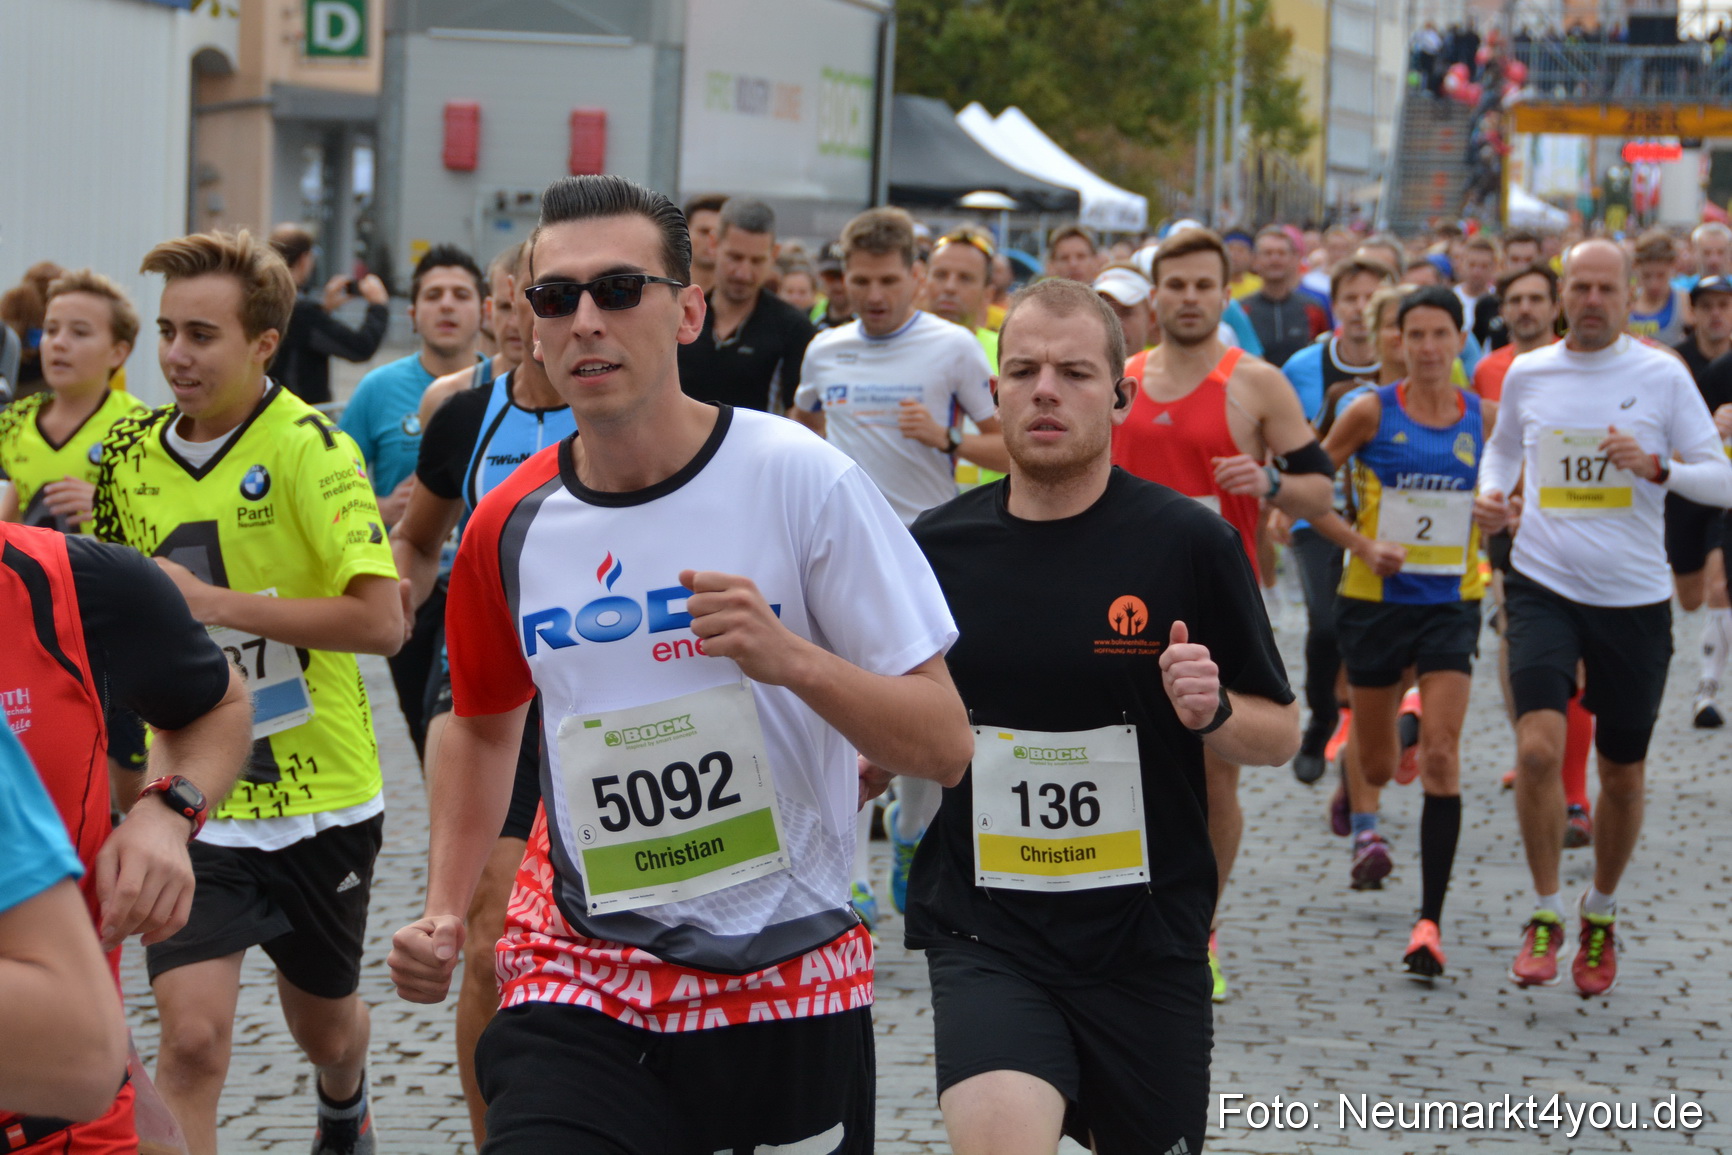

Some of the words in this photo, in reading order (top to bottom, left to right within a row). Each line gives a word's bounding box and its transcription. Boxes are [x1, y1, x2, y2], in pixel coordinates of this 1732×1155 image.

[312, 2, 360, 51] D
[1561, 457, 1609, 482] 187
[237, 503, 274, 521] Partl
[1416, 517, 1432, 540] 2
[622, 714, 695, 744] BOCK
[1029, 747, 1088, 761] BOCK
[592, 751, 741, 833] 5092
[1011, 780, 1100, 829] 136
[982, 817, 988, 826] A
[584, 829, 591, 840] S
[635, 837, 724, 872] Christian
[1021, 845, 1096, 864] Christian
